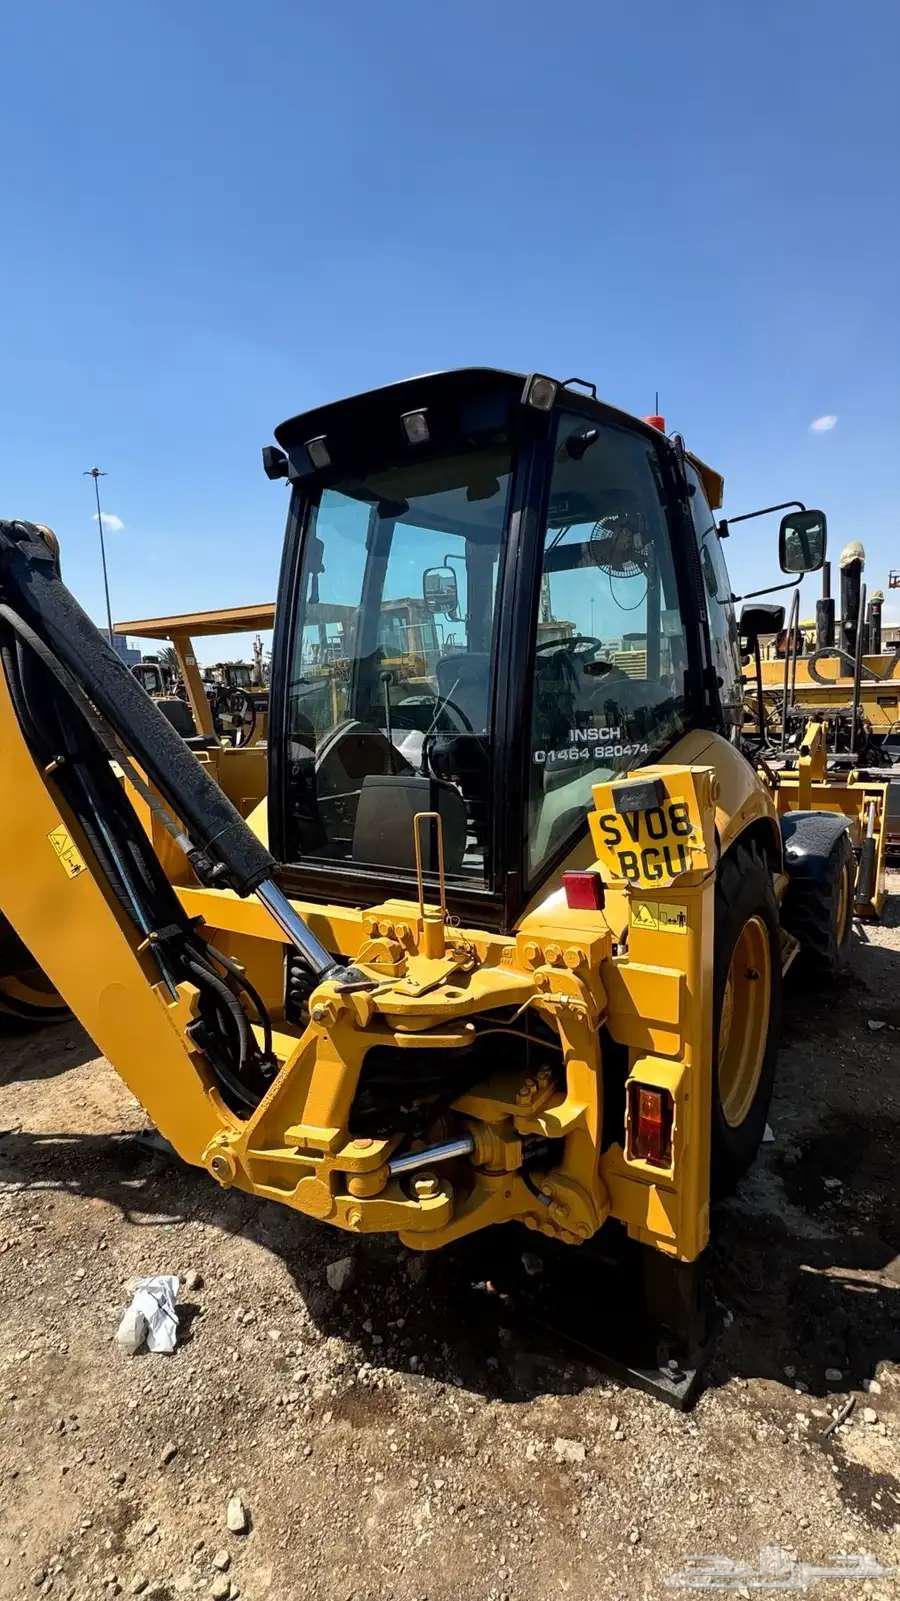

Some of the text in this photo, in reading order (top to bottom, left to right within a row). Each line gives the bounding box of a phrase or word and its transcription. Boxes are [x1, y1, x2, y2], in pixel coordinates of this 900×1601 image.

[569, 726, 621, 742] INSCH
[534, 743, 649, 763] 01464 820474
[600, 803, 693, 846] SV08
[618, 844, 688, 881] BGU
